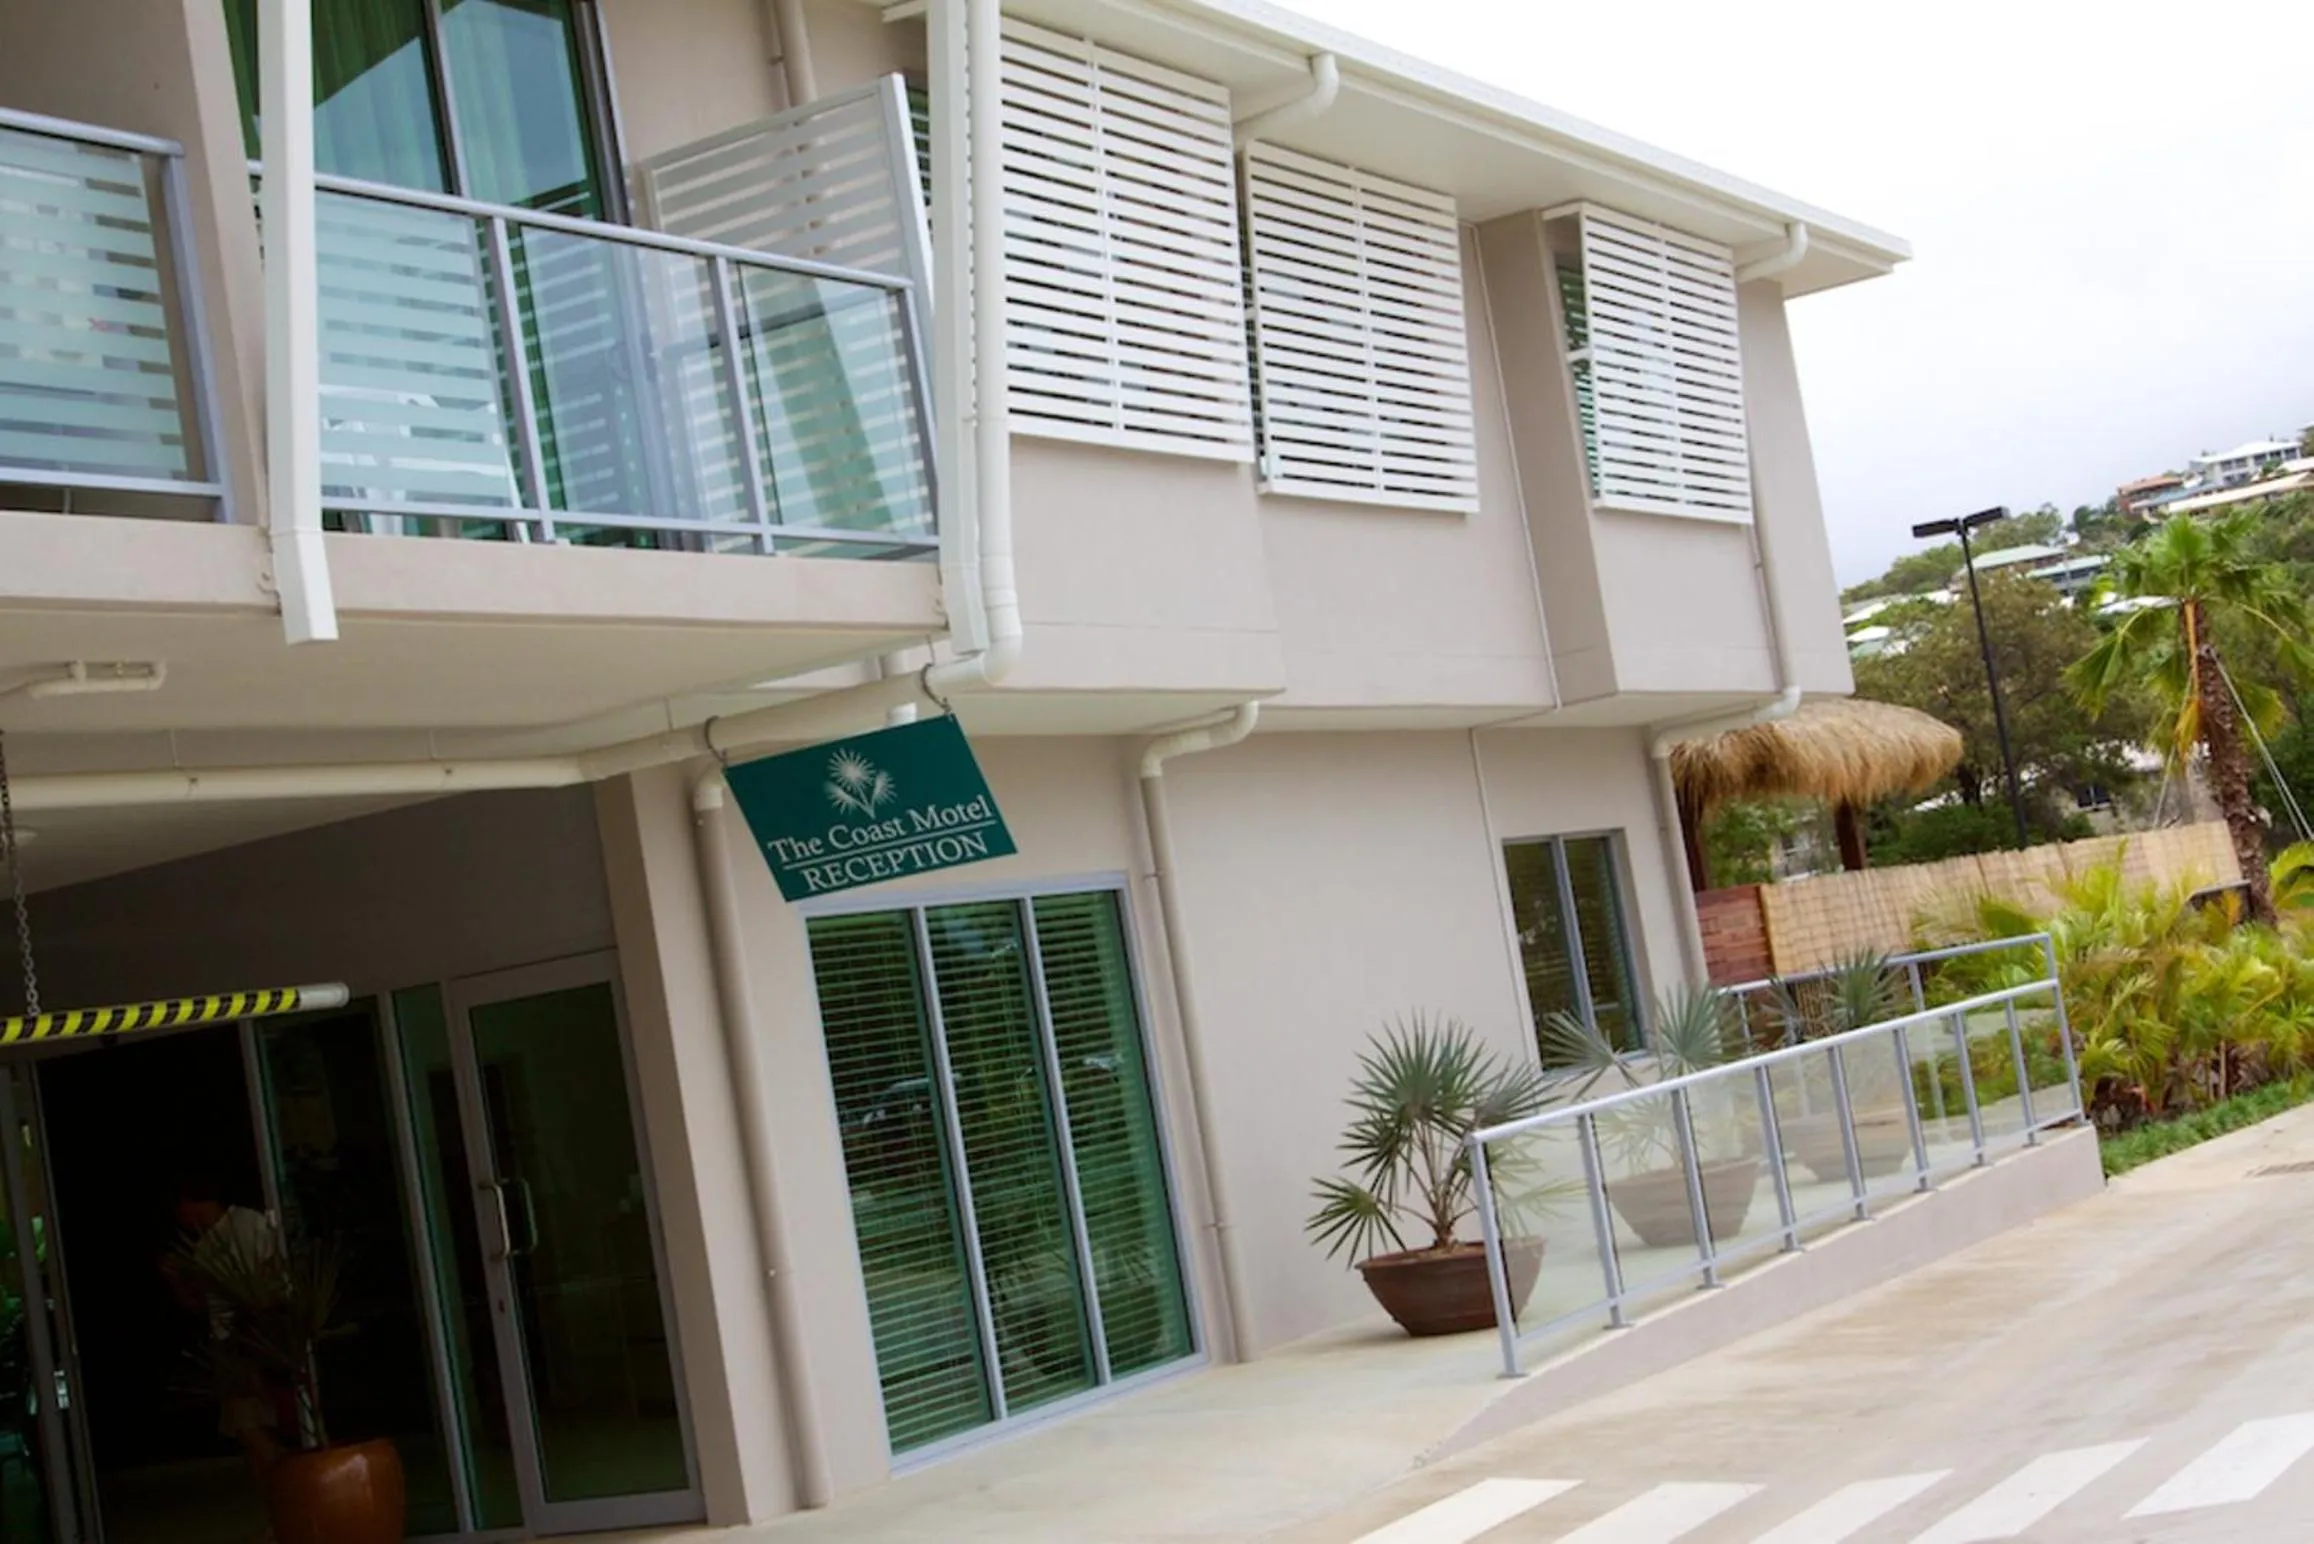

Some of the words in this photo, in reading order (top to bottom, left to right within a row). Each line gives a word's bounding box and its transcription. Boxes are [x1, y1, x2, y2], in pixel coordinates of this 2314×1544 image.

[768, 837, 824, 863] The
[829, 818, 906, 850] Coast
[907, 795, 992, 832] Motel
[801, 833, 988, 891] RECEPTION
